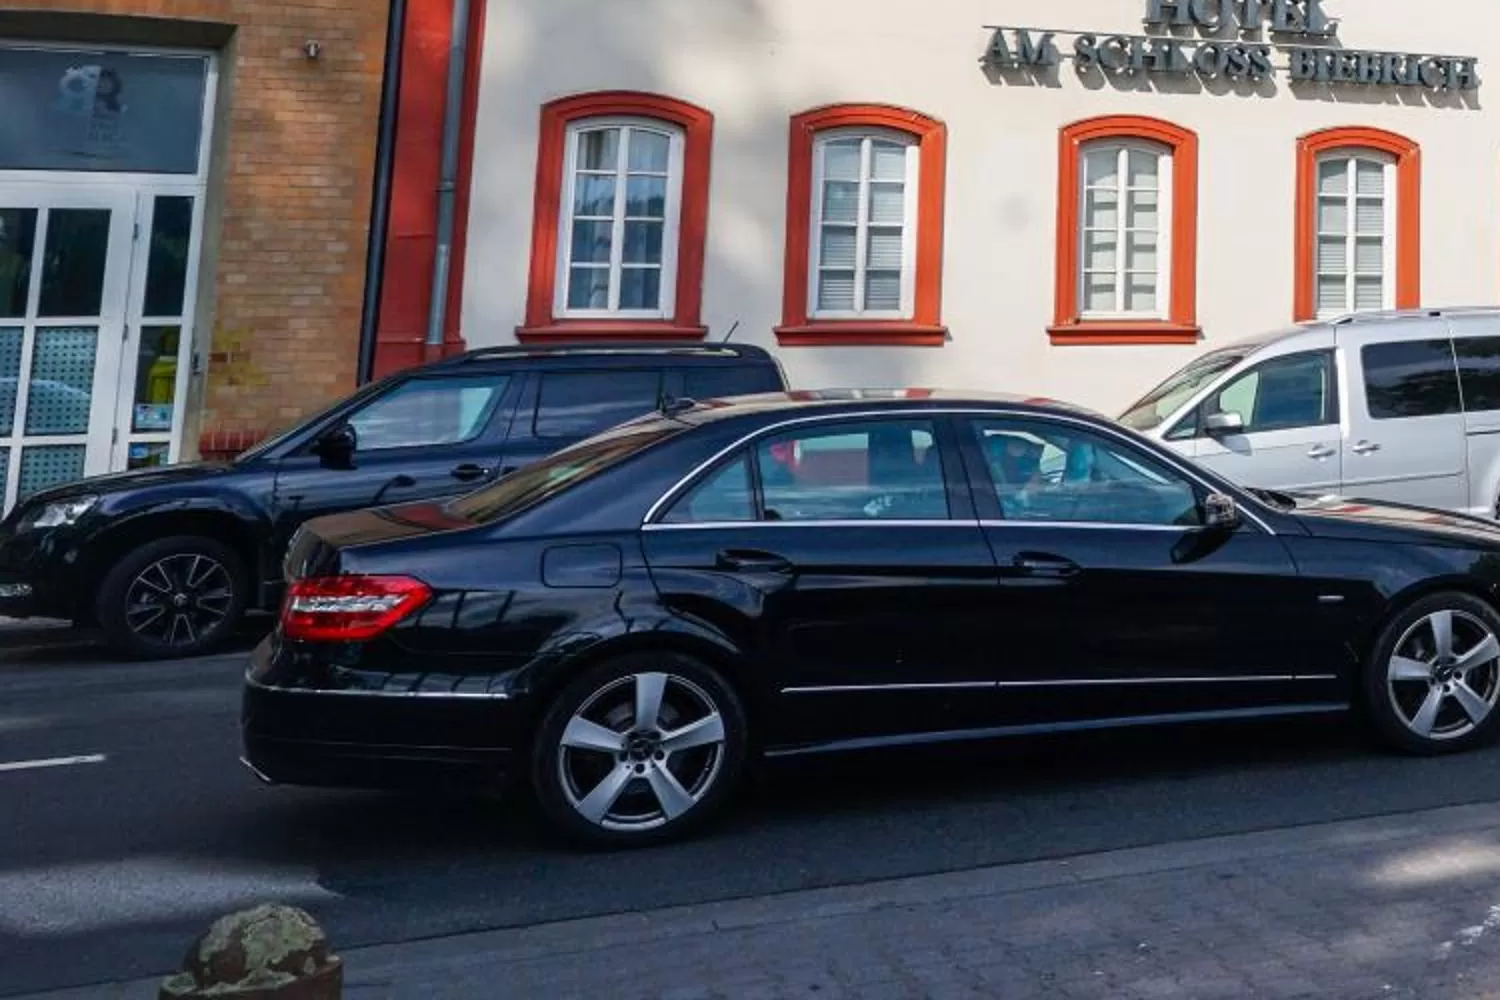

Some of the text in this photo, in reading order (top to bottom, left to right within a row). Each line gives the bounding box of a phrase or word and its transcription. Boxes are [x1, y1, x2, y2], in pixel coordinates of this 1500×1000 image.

[978, 27, 1482, 90] AM SCHLOSS BIEBRICH
